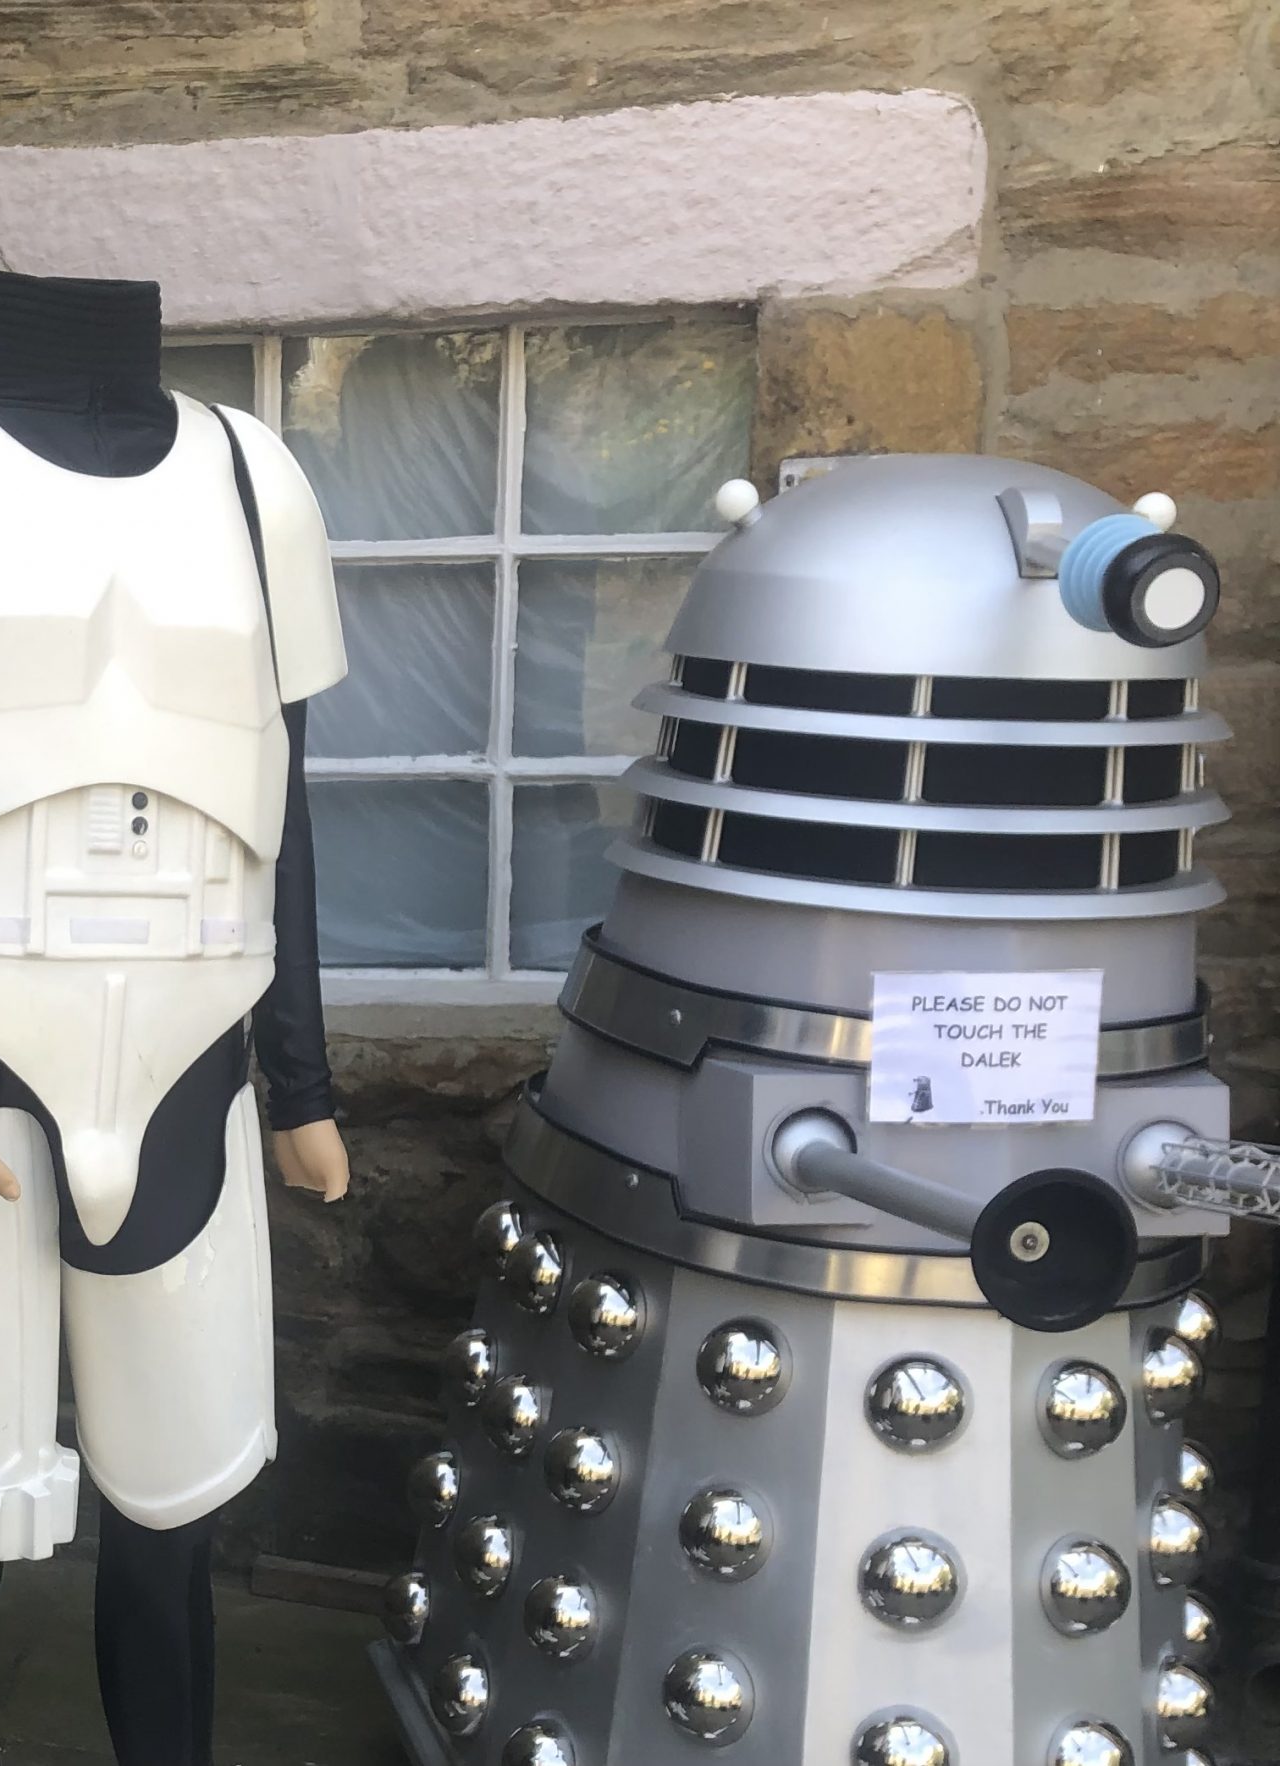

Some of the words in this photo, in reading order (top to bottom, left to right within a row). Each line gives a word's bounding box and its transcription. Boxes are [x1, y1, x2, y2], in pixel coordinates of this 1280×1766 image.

[911, 996, 985, 1012] PLEASE
[994, 996, 1021, 1012] DO
[1028, 995, 1068, 1012] NOT
[934, 1024, 1003, 1040] TOUCH
[1012, 1022, 1048, 1040] THE
[960, 1052, 1022, 1068] DALEK
[1042, 1100, 1069, 1114] You
